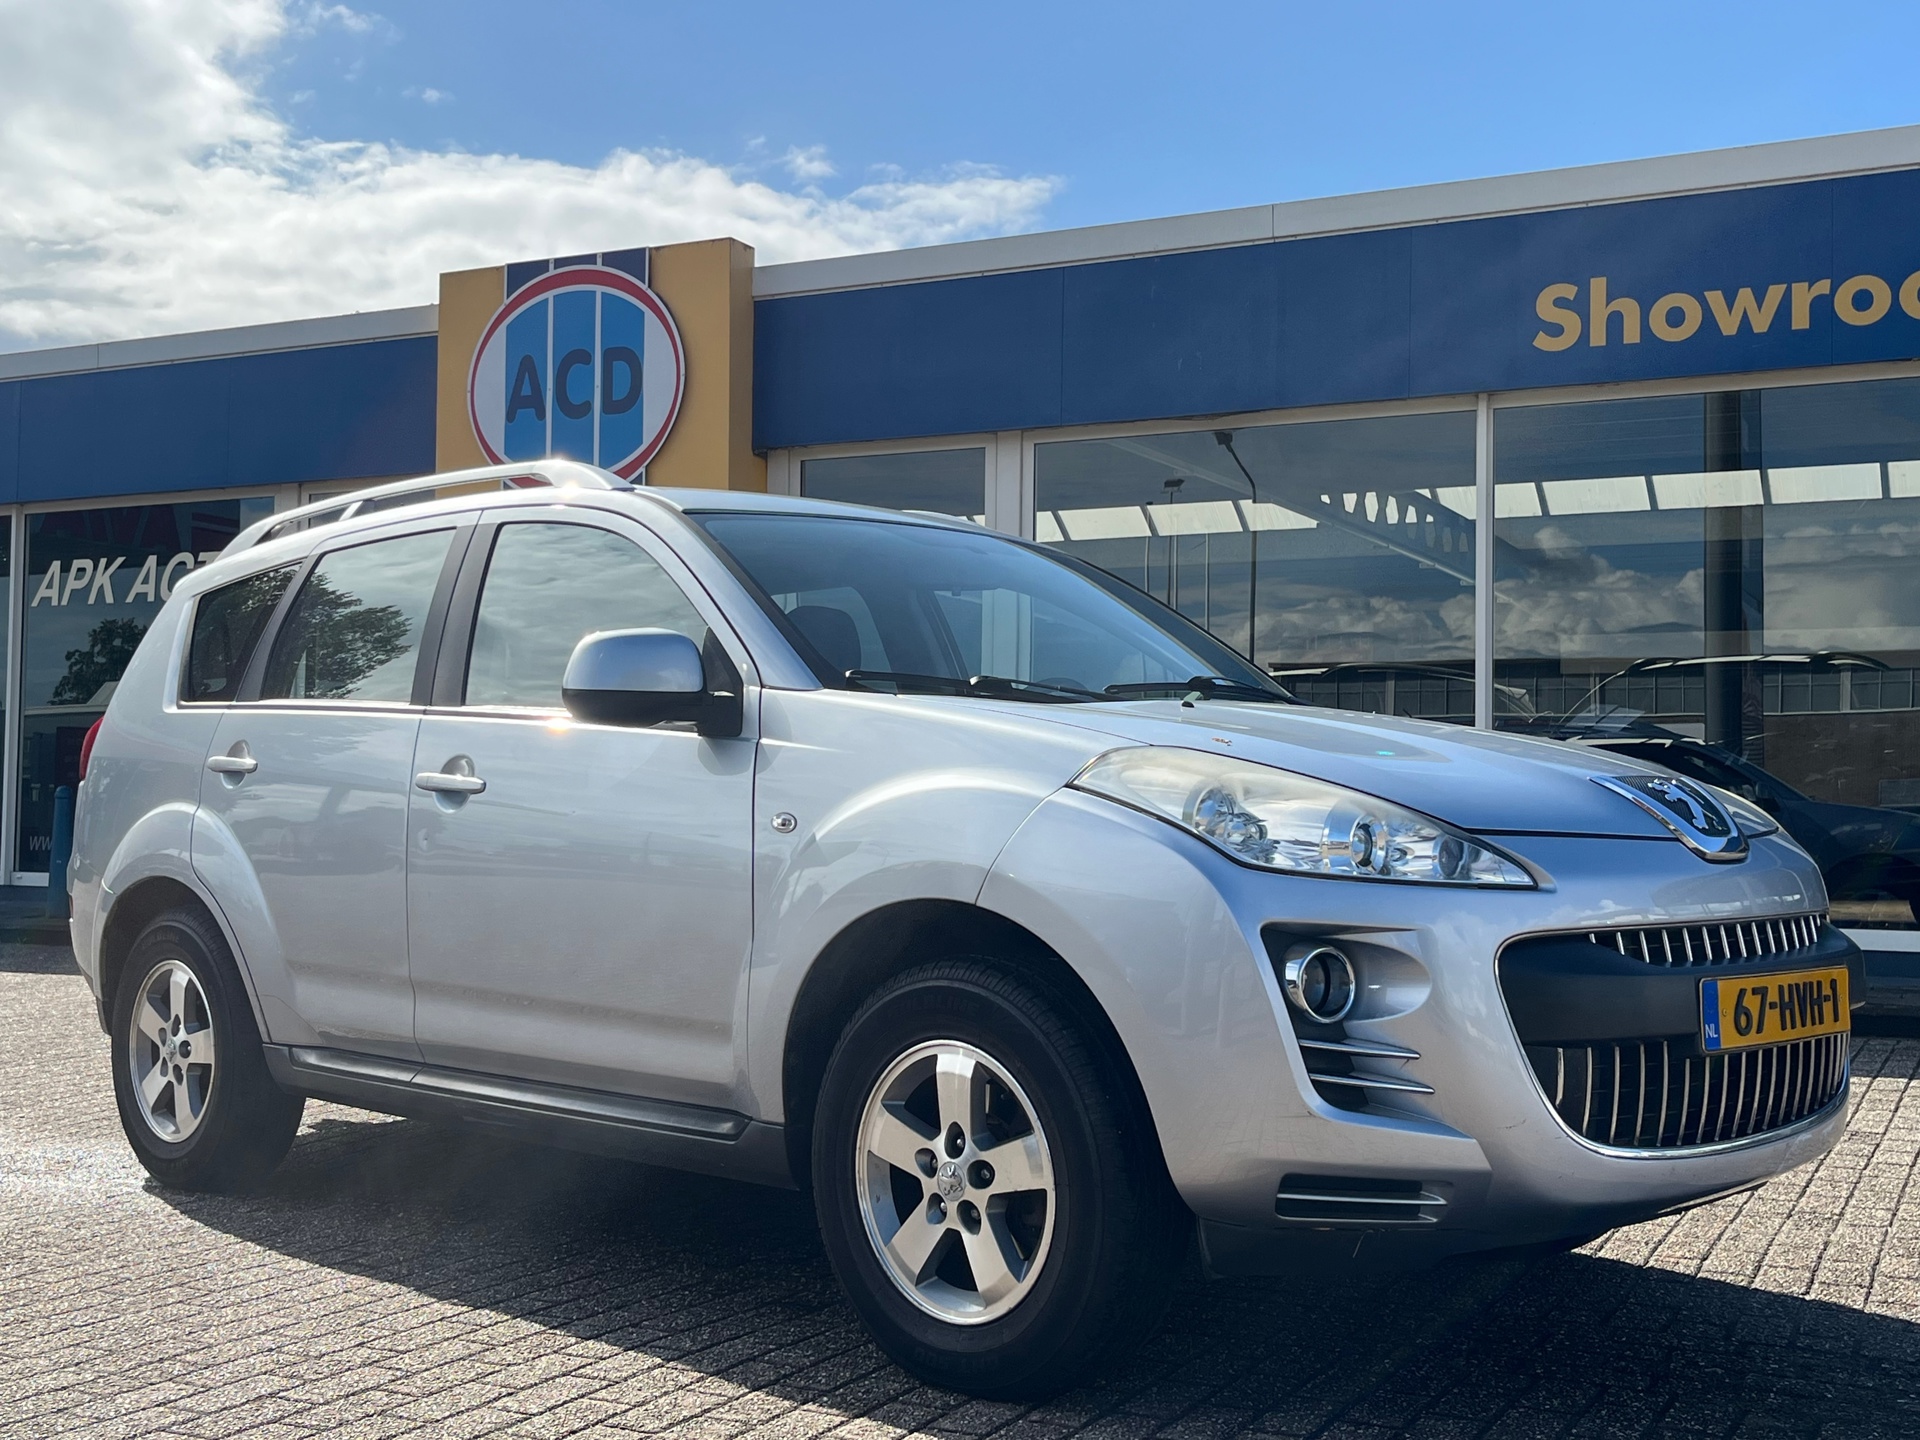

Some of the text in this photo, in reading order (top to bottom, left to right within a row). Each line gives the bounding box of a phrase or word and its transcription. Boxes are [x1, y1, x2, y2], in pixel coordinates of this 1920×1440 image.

[506, 346, 643, 424] ACD
[31, 556, 127, 608] APK
[1705, 1024, 1719, 1039] NL
[1733, 978, 1840, 1037] 67-HVH-1
